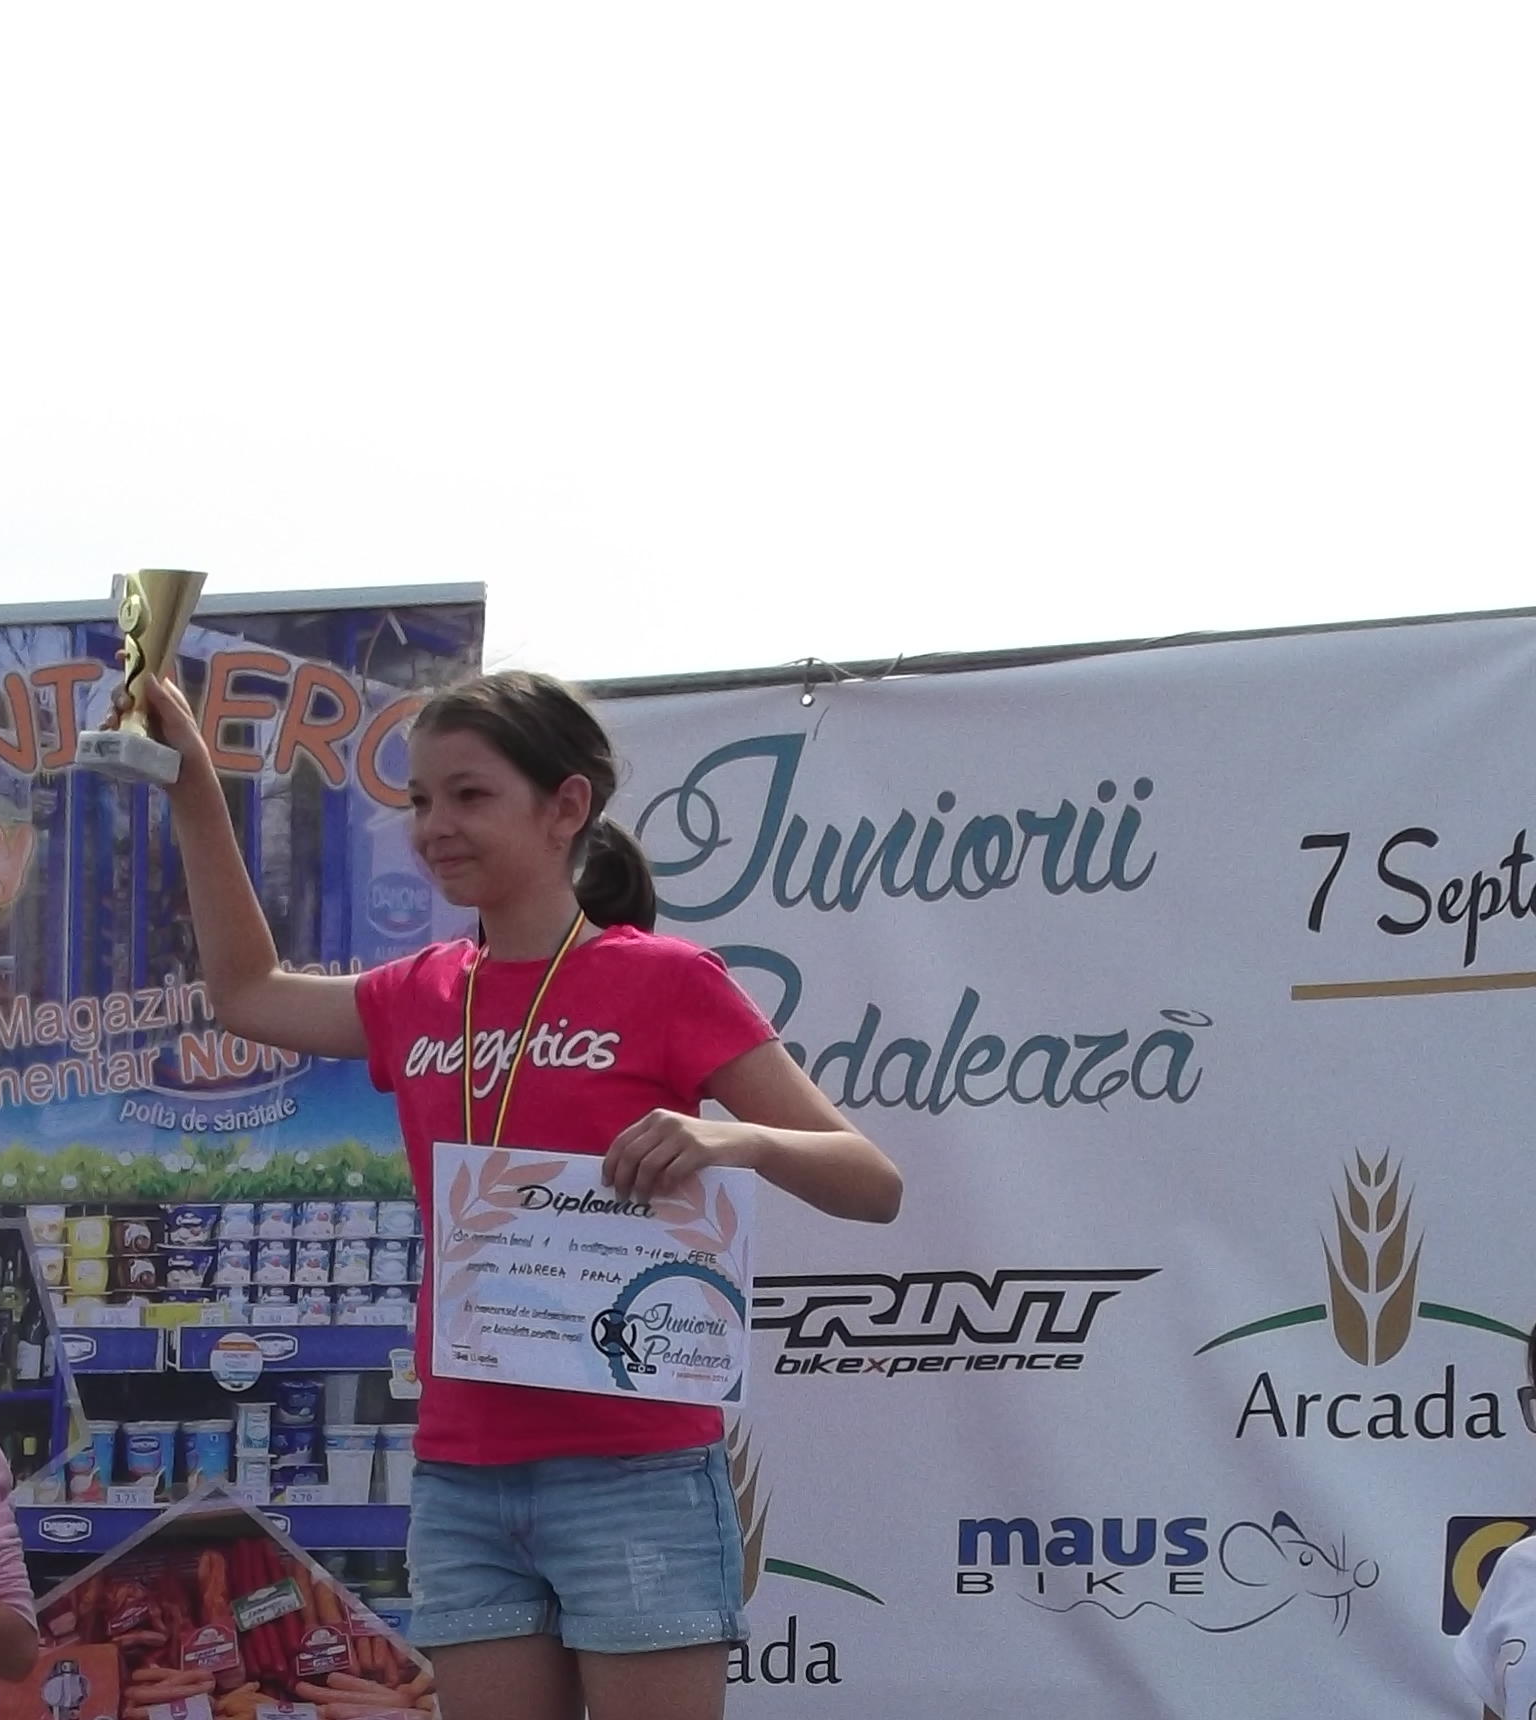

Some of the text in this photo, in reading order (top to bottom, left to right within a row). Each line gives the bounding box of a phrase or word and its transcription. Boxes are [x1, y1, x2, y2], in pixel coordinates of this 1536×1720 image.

[637, 733, 1156, 922] Juniorii
[1300, 832, 1350, 932] 7
[405, 1018, 621, 1098] energetics
[181, 1106, 209, 1132] de
[517, 1184, 657, 1220] Diploma
[508, 1262, 567, 1280] ANDREEA
[580, 1268, 623, 1285] PRALA
[774, 1352, 1085, 1378] bikexperience
[1234, 1364, 1506, 1441] Arcada
[957, 1515, 1210, 1567] maus
[955, 1571, 1206, 1595] BIKE
